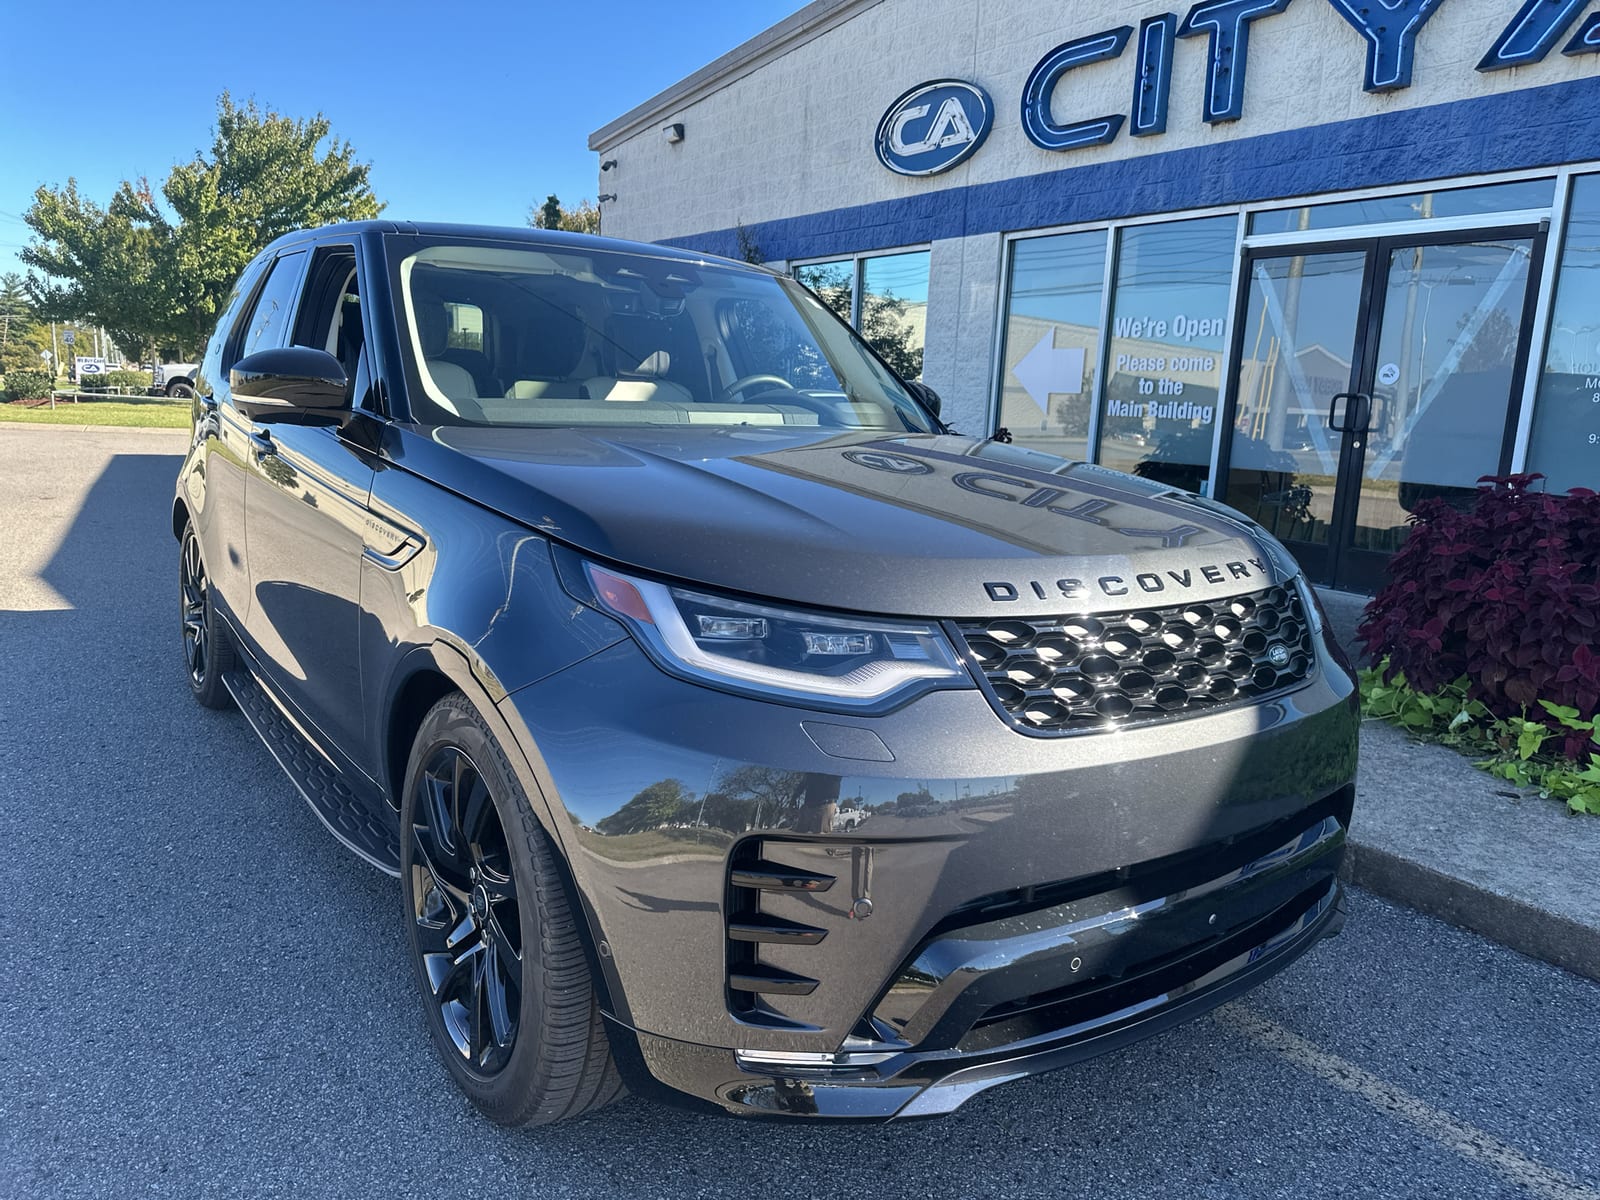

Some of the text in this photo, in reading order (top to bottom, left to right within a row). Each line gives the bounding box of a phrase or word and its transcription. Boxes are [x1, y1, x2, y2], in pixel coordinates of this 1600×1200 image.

[888, 96, 977, 157] CA
[1115, 315, 1224, 341] We're Open
[1117, 354, 1214, 372] Please come
[1138, 378, 1184, 396] to the
[1107, 400, 1213, 424] Main Building
[365, 519, 399, 542] DISCOVERY
[983, 557, 1268, 602] DISCOVERY
